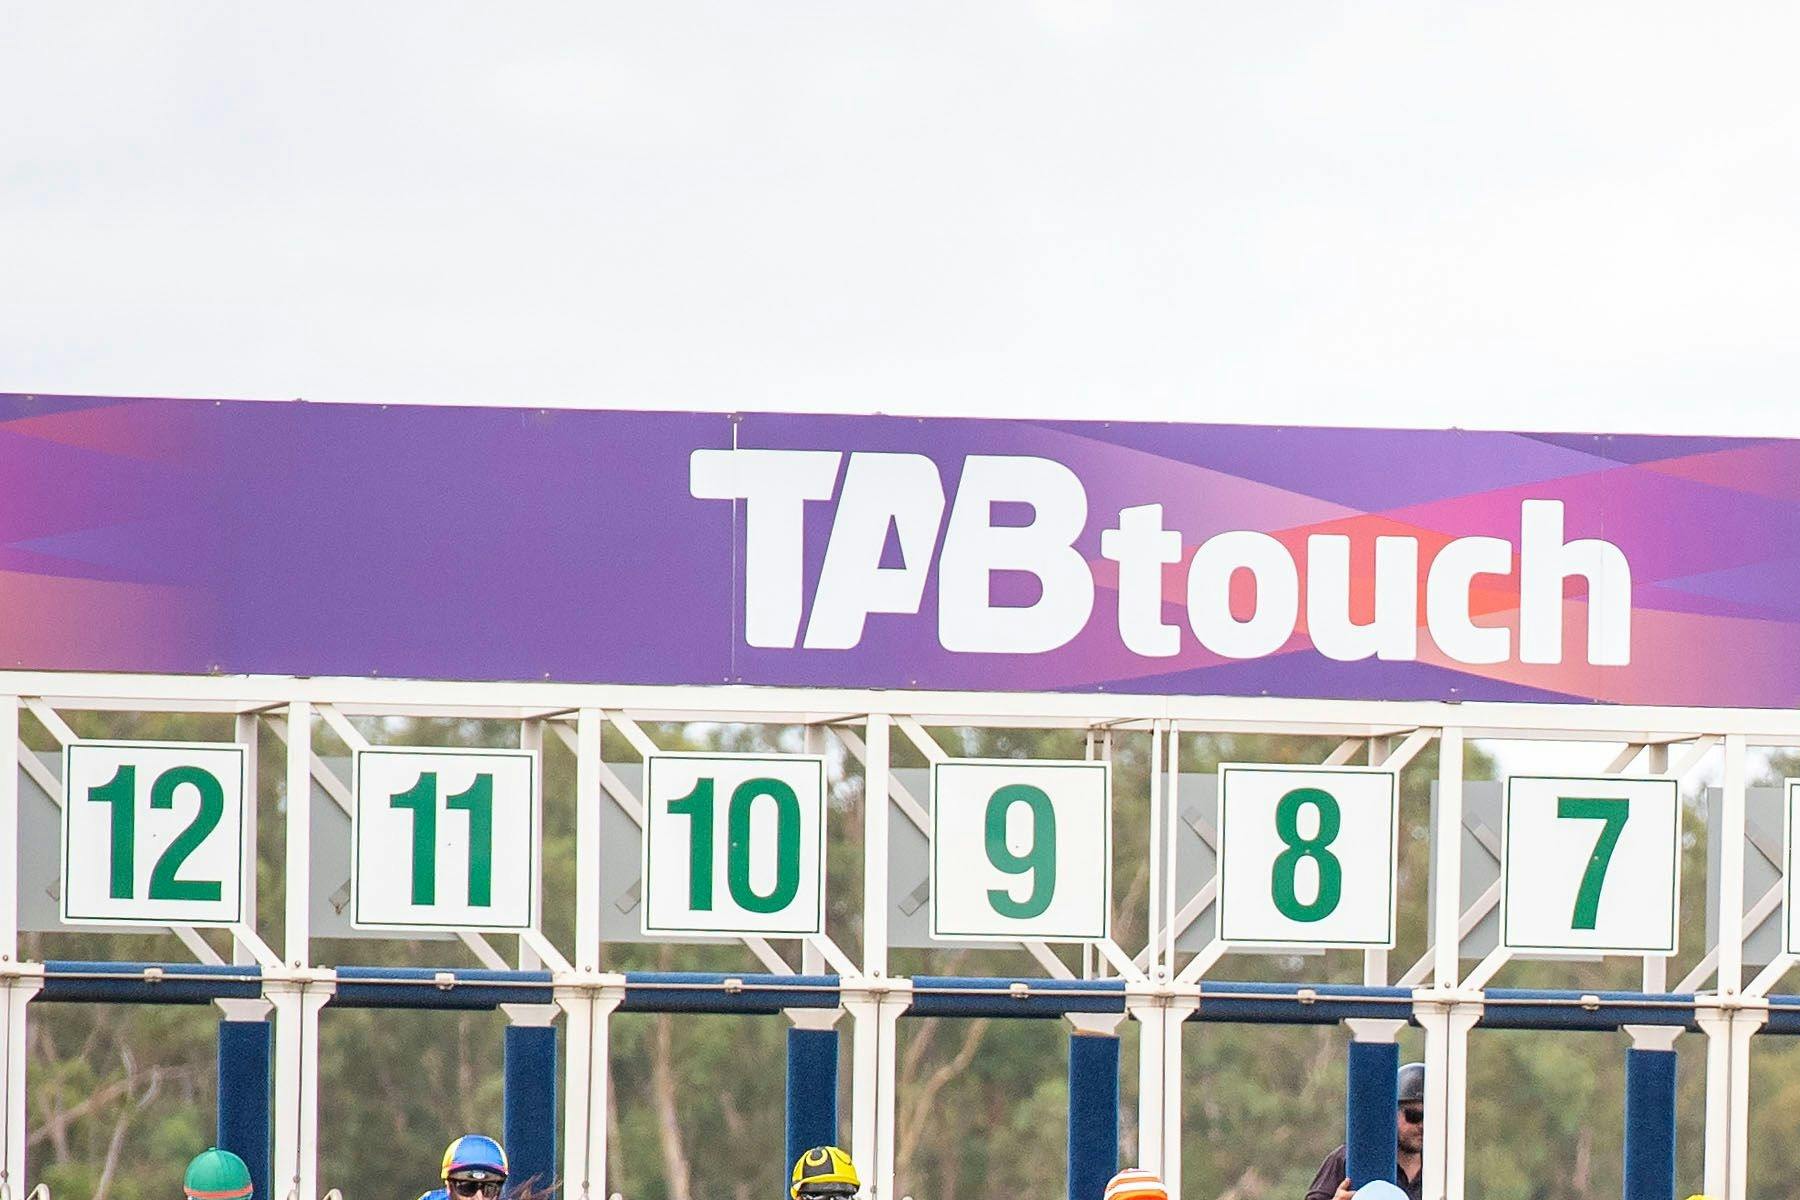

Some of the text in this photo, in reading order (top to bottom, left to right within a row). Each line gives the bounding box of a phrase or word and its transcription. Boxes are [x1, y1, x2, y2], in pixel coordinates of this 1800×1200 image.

[690, 449, 1631, 669] TABtouch
[87, 765, 225, 902] 12
[389, 771, 493, 908] 11
[666, 777, 801, 914] 10
[985, 785, 1057, 917] 9
[1272, 788, 1342, 922] 8
[1557, 797, 1629, 929] 7
